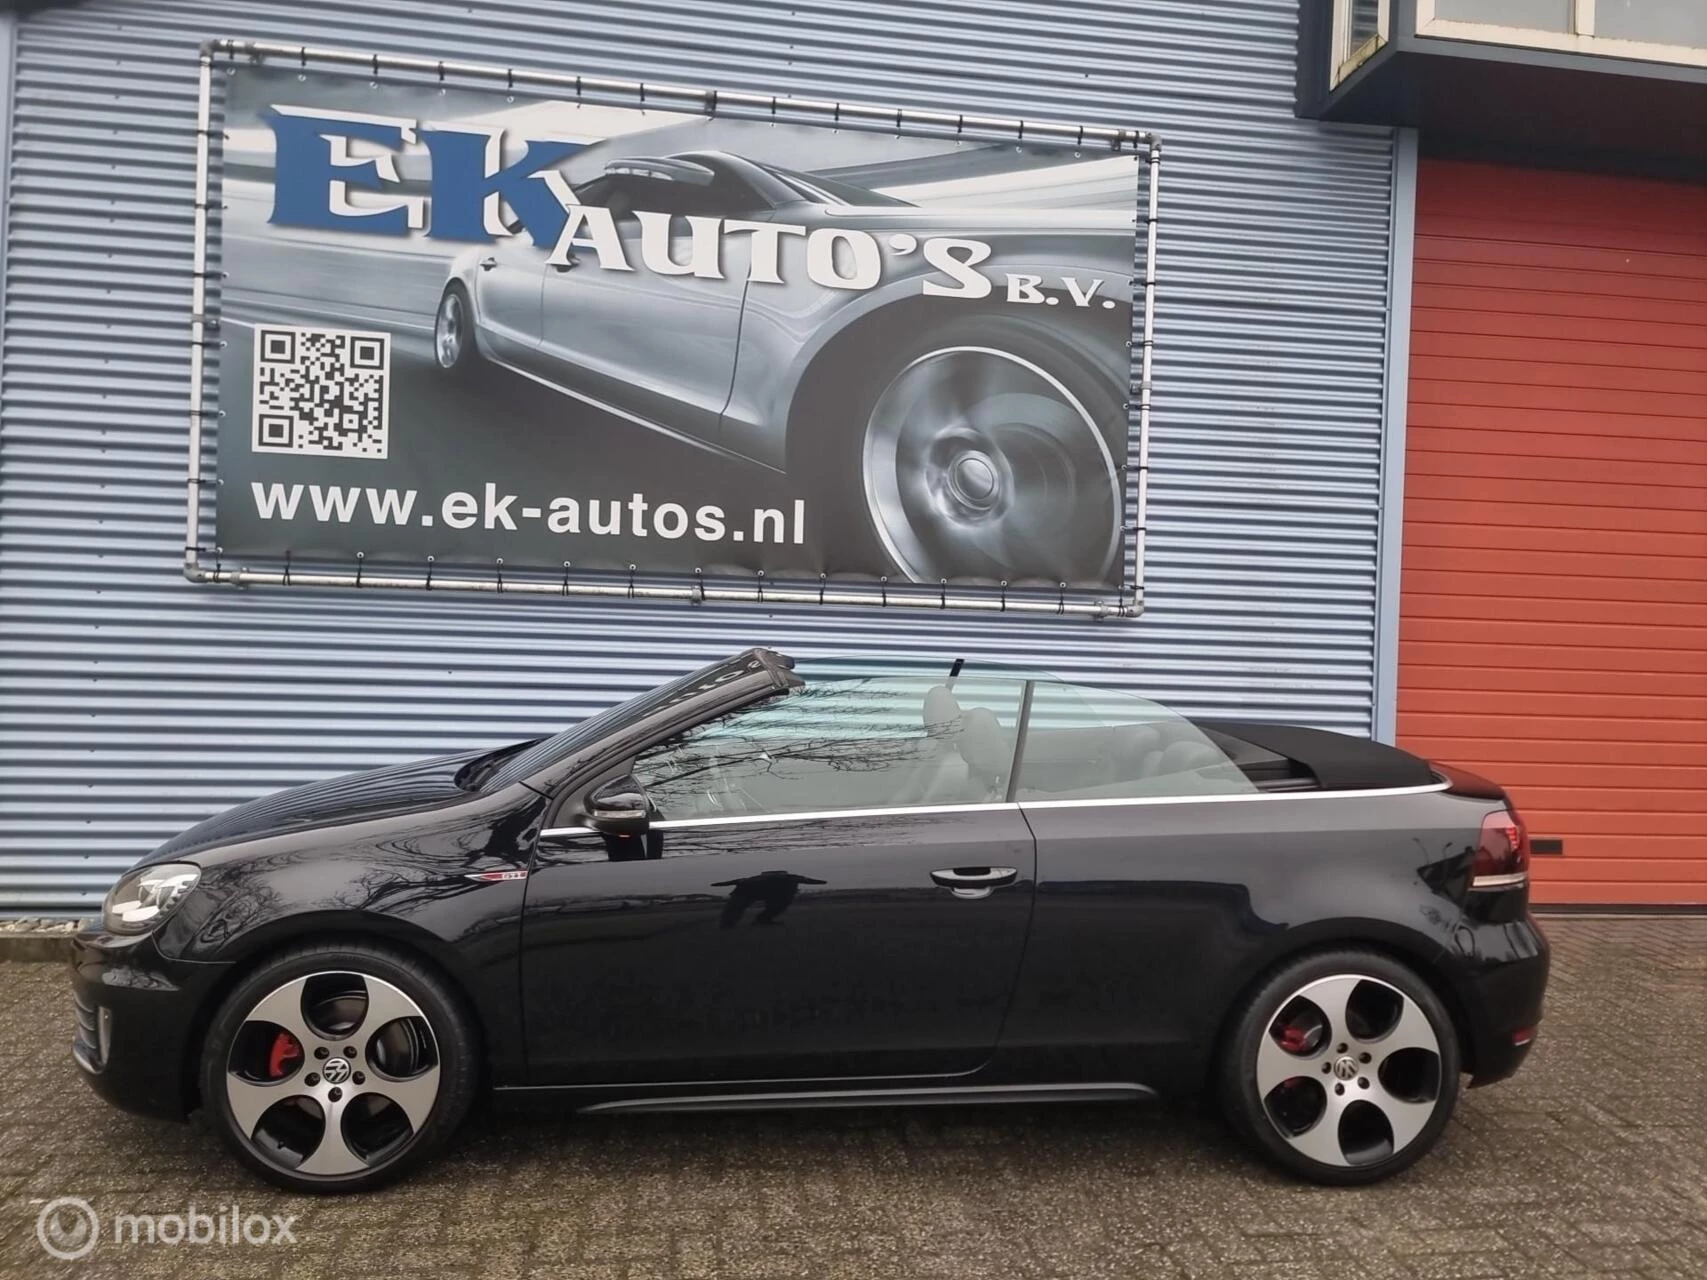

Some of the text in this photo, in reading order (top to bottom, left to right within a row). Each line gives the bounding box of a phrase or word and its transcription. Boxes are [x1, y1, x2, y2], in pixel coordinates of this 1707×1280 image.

[262, 104, 607, 249] EK
[1005, 273, 1116, 309] B.V.
[251, 481, 806, 545] www.ek-autos.nl
